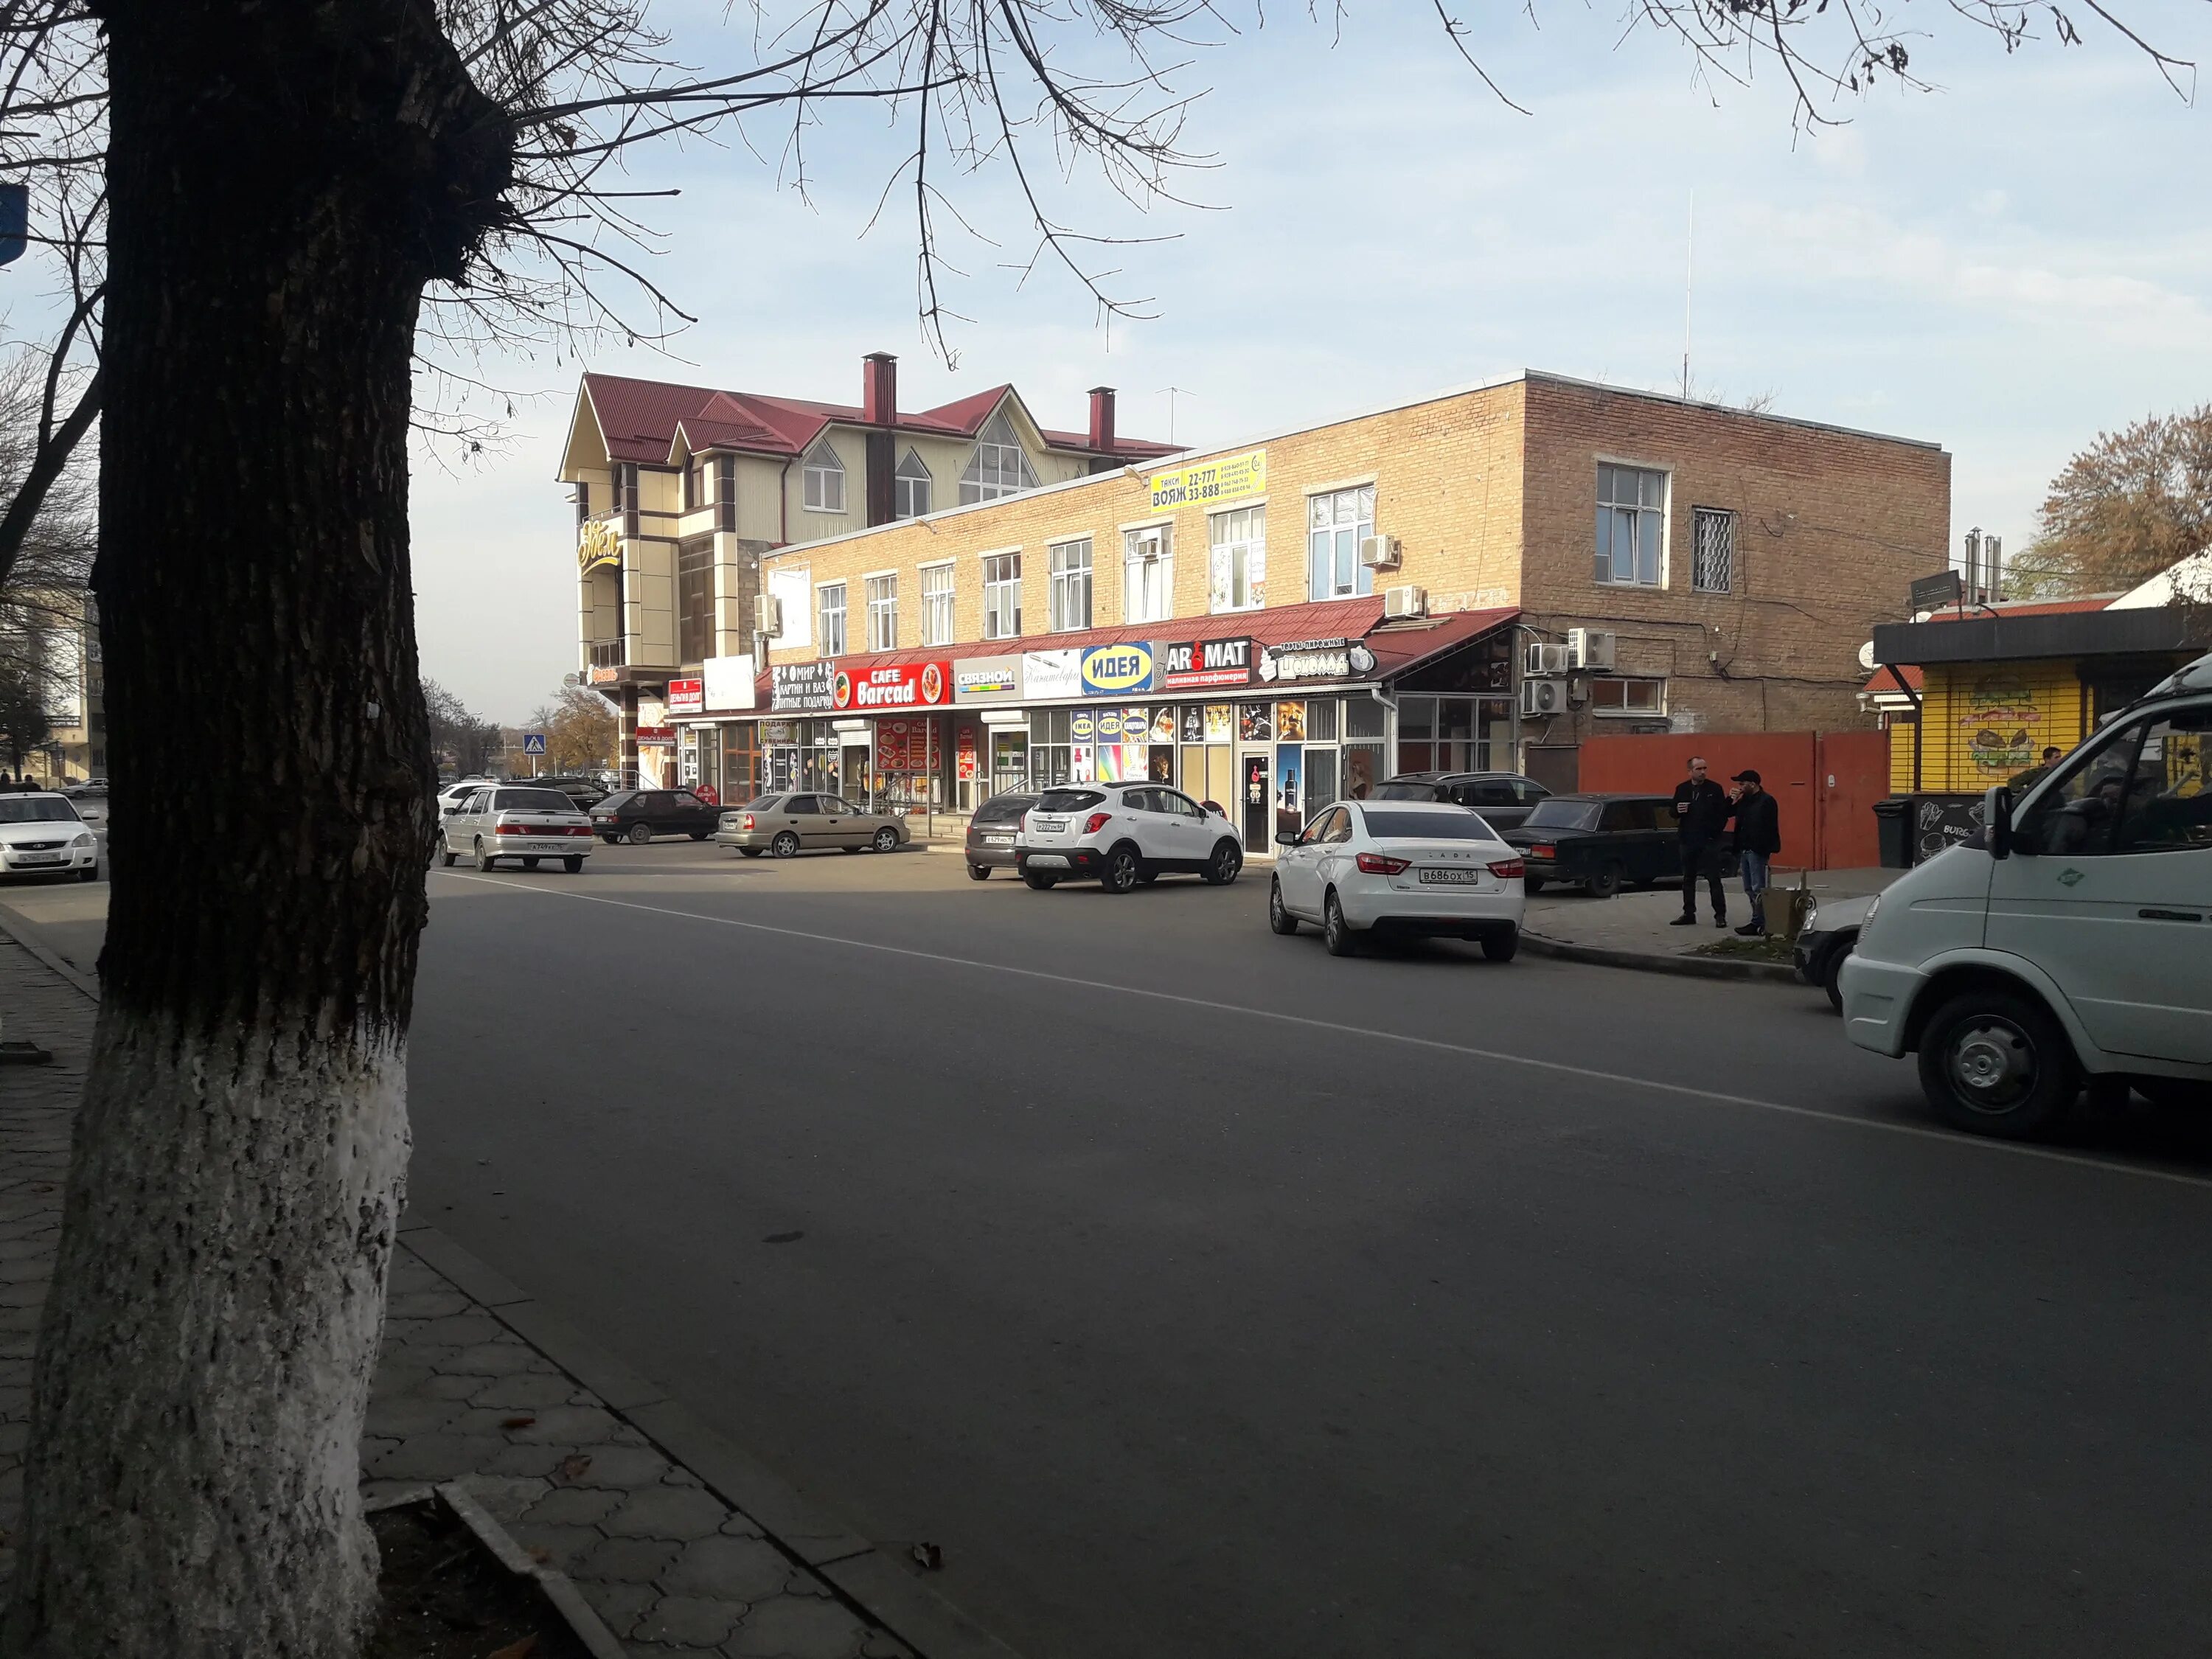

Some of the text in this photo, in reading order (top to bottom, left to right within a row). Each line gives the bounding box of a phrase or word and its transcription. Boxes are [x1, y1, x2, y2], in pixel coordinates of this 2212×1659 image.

[1161, 476, 1180, 488] ТАКСИ
[1189, 469, 1216, 487] 22-777
[1152, 486, 1186, 507] ВОЯЖ
[1189, 483, 1220, 501] 33-888
[1092, 655, 1140, 679] ИДЕЯ
[870, 669, 901, 684] CAFE
[1167, 672, 1247, 684] наливная парфюмерия
[780, 681, 826, 695] КАРТИН И ВАЗ
[857, 678, 916, 706] Barcad
[1100, 721, 1120, 731] ИДЕЯ
[1424, 871, 1462, 881] В686ОХ
